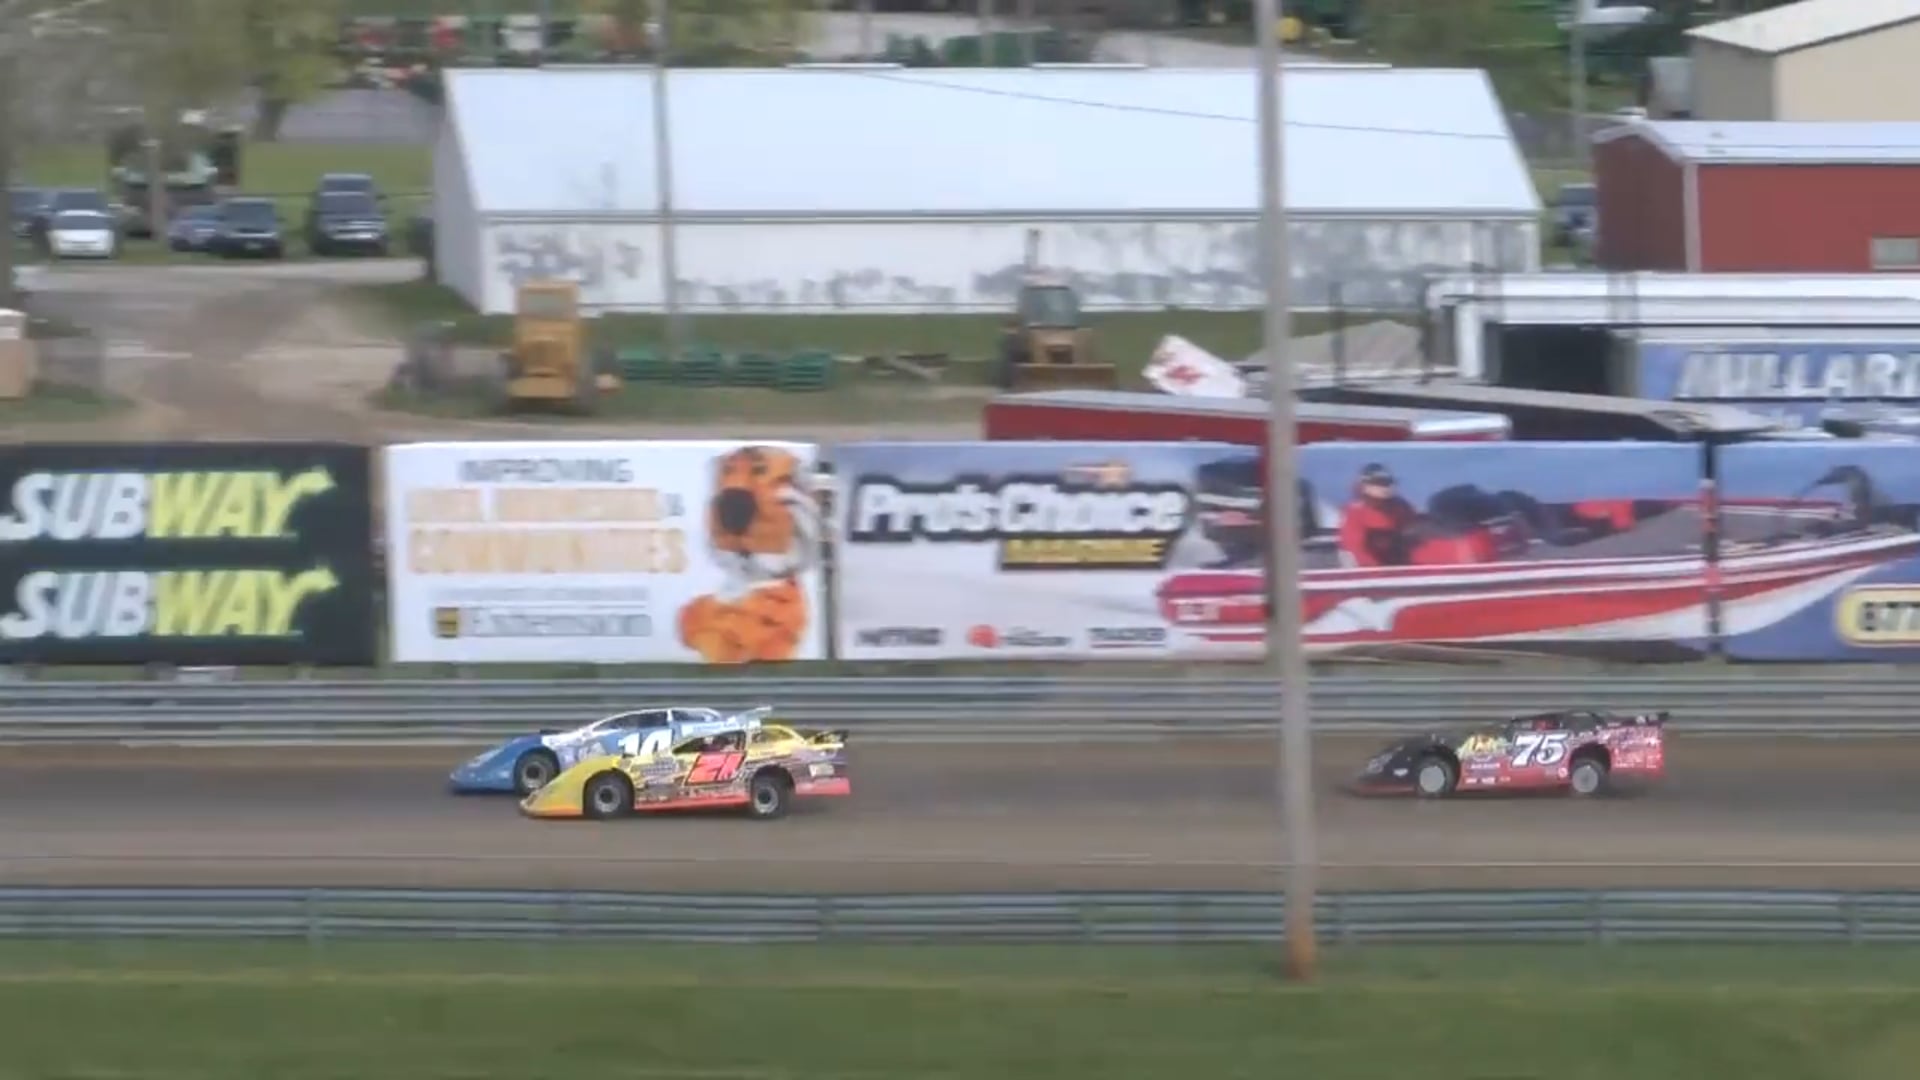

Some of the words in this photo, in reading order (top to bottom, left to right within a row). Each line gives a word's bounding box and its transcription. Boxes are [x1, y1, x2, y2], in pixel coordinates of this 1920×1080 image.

[0, 465, 336, 540] SUBWAY
[853, 480, 998, 534] Pro's
[998, 480, 1188, 533] Choice
[0, 563, 340, 638] SUBWAY
[1511, 732, 1569, 769] 75
